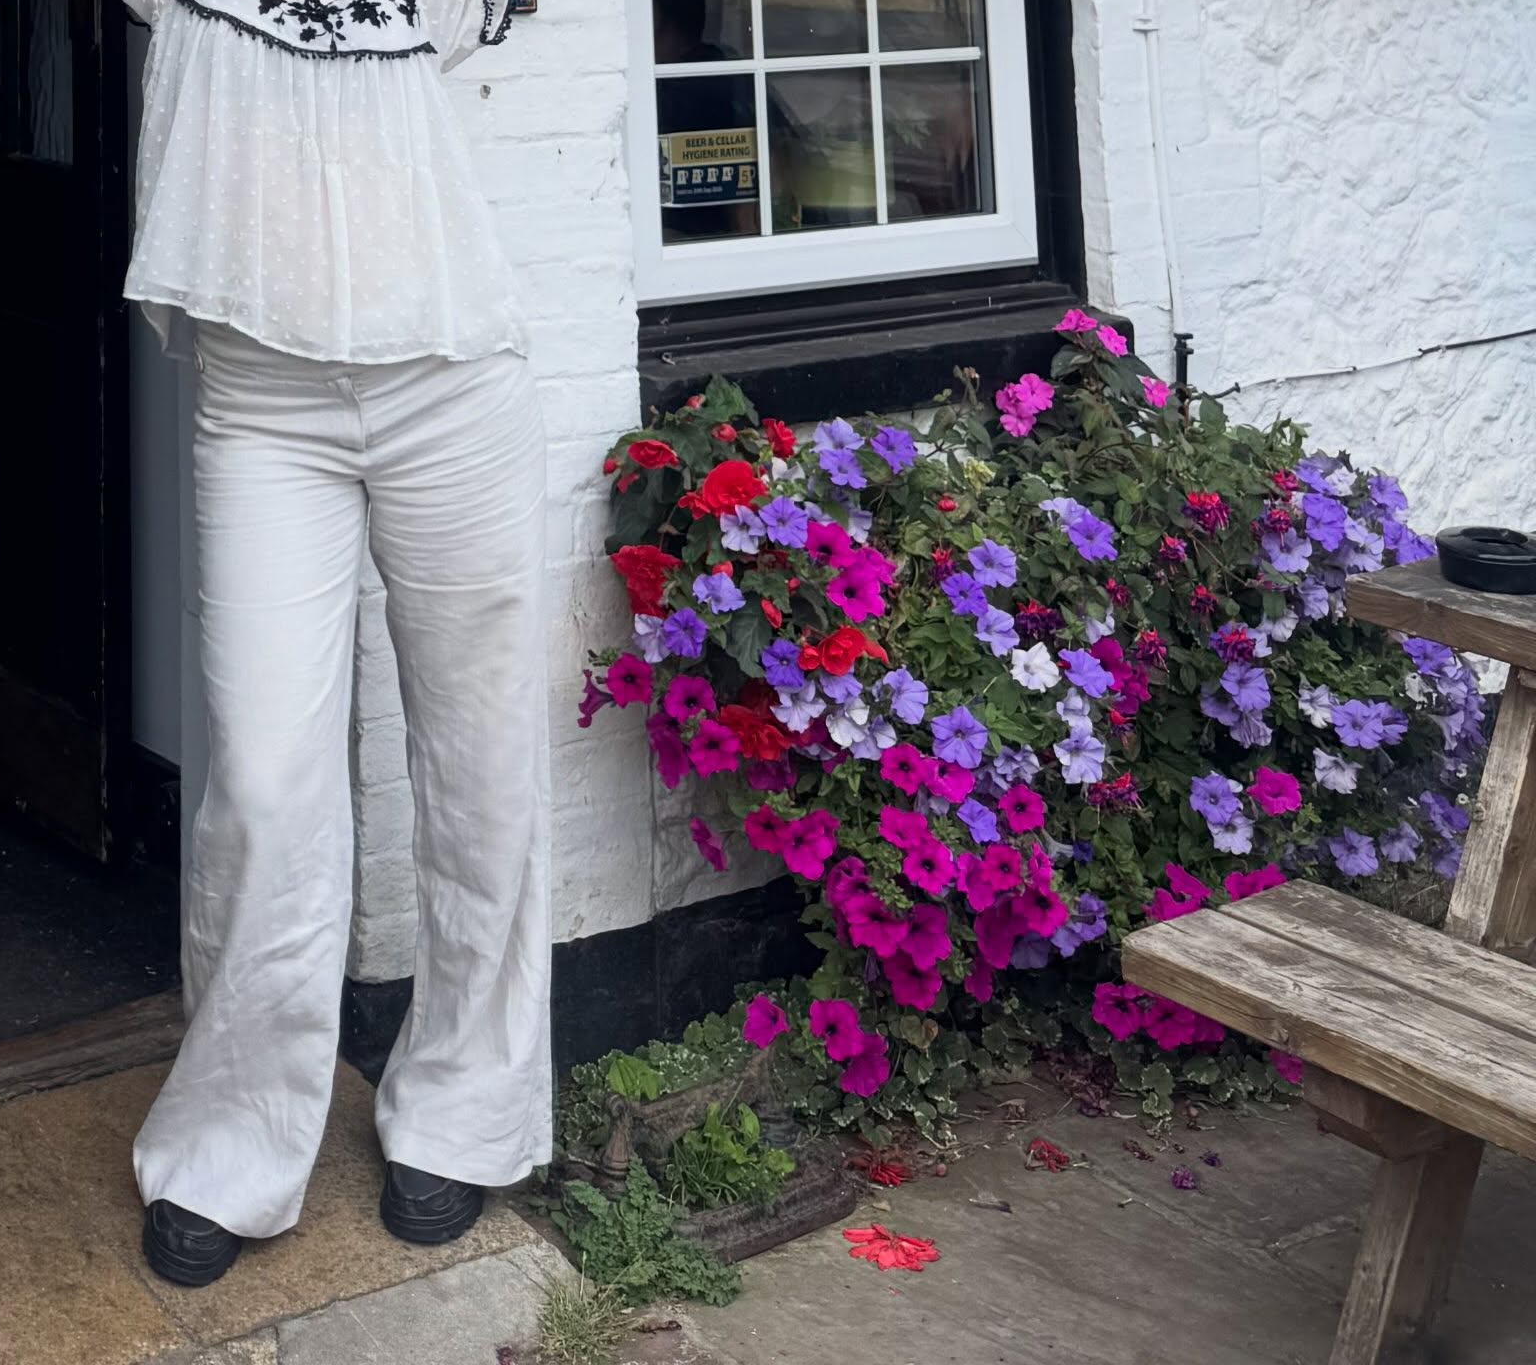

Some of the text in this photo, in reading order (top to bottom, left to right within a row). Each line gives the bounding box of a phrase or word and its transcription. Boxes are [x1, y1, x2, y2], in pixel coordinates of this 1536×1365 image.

[686, 138, 707, 148] BEER
[716, 135, 746, 145] CELLAR
[682, 147, 750, 160] HYGIENE RATING
[741, 170, 749, 183] 5
